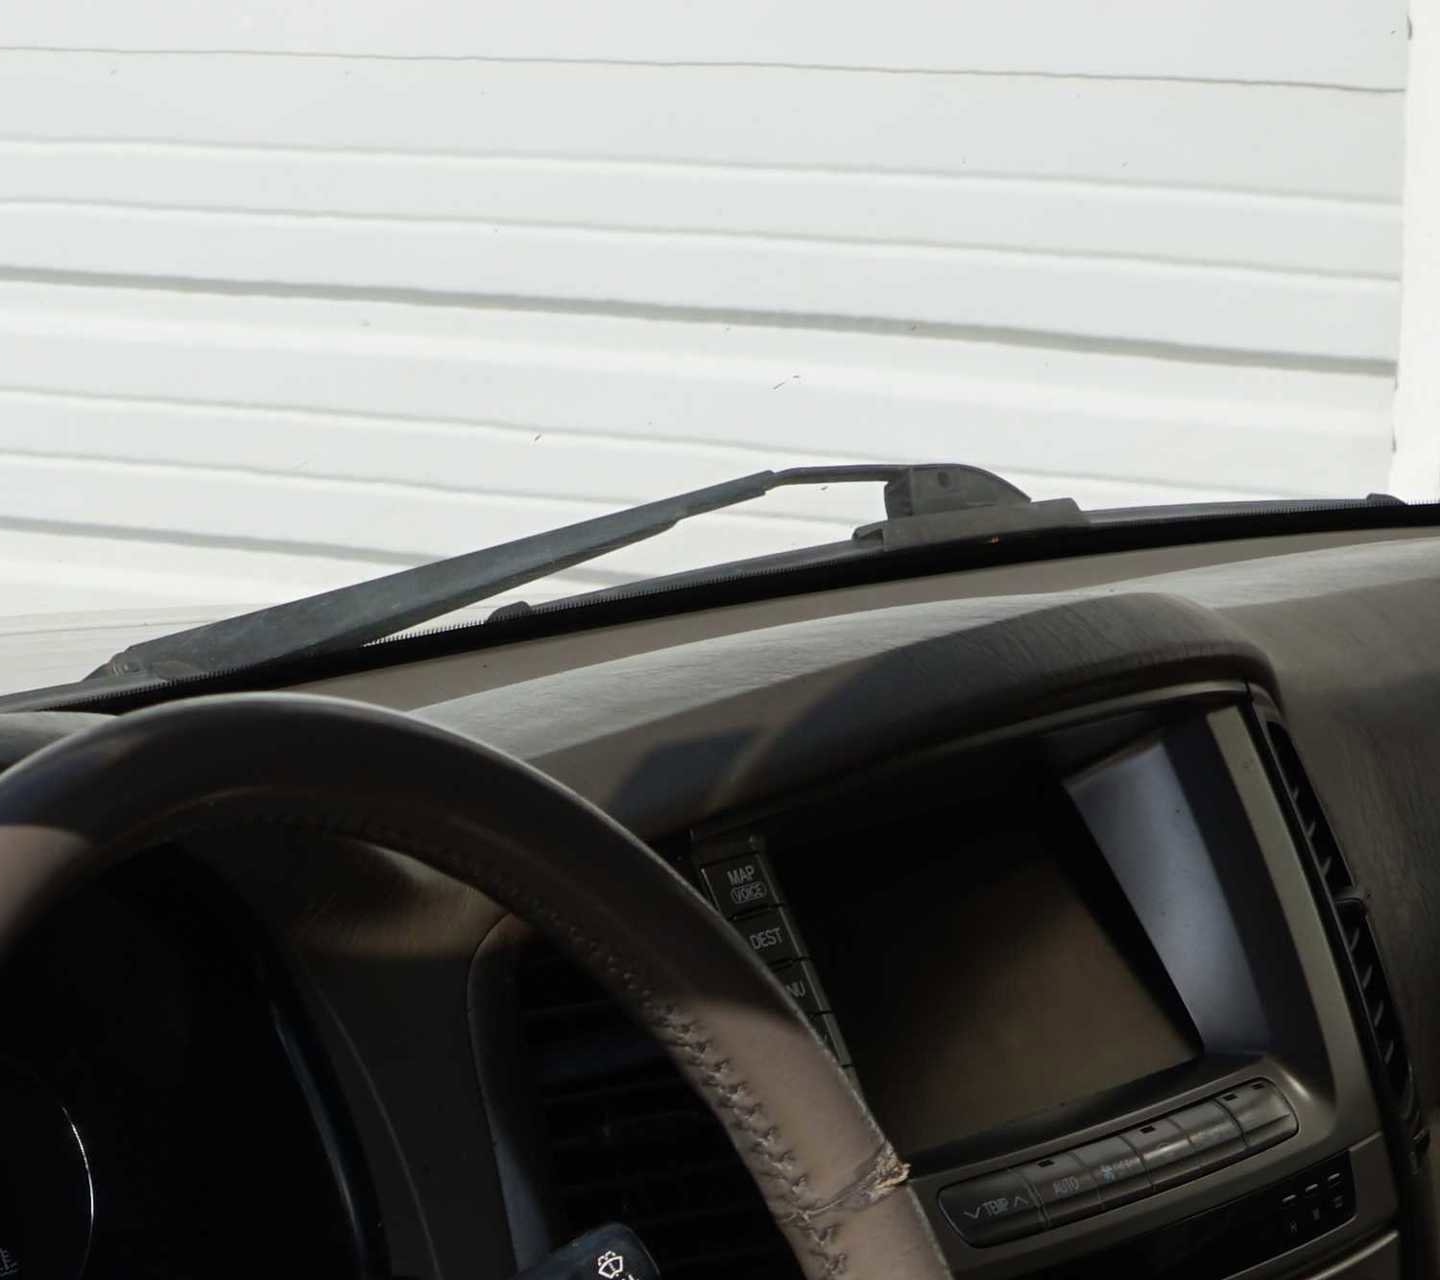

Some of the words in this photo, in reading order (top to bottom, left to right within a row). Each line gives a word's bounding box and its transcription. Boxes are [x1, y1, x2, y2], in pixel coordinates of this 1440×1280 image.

[727, 865, 755, 885] MAP
[733, 883, 765, 903] VOICE
[749, 928, 783, 950] DEST
